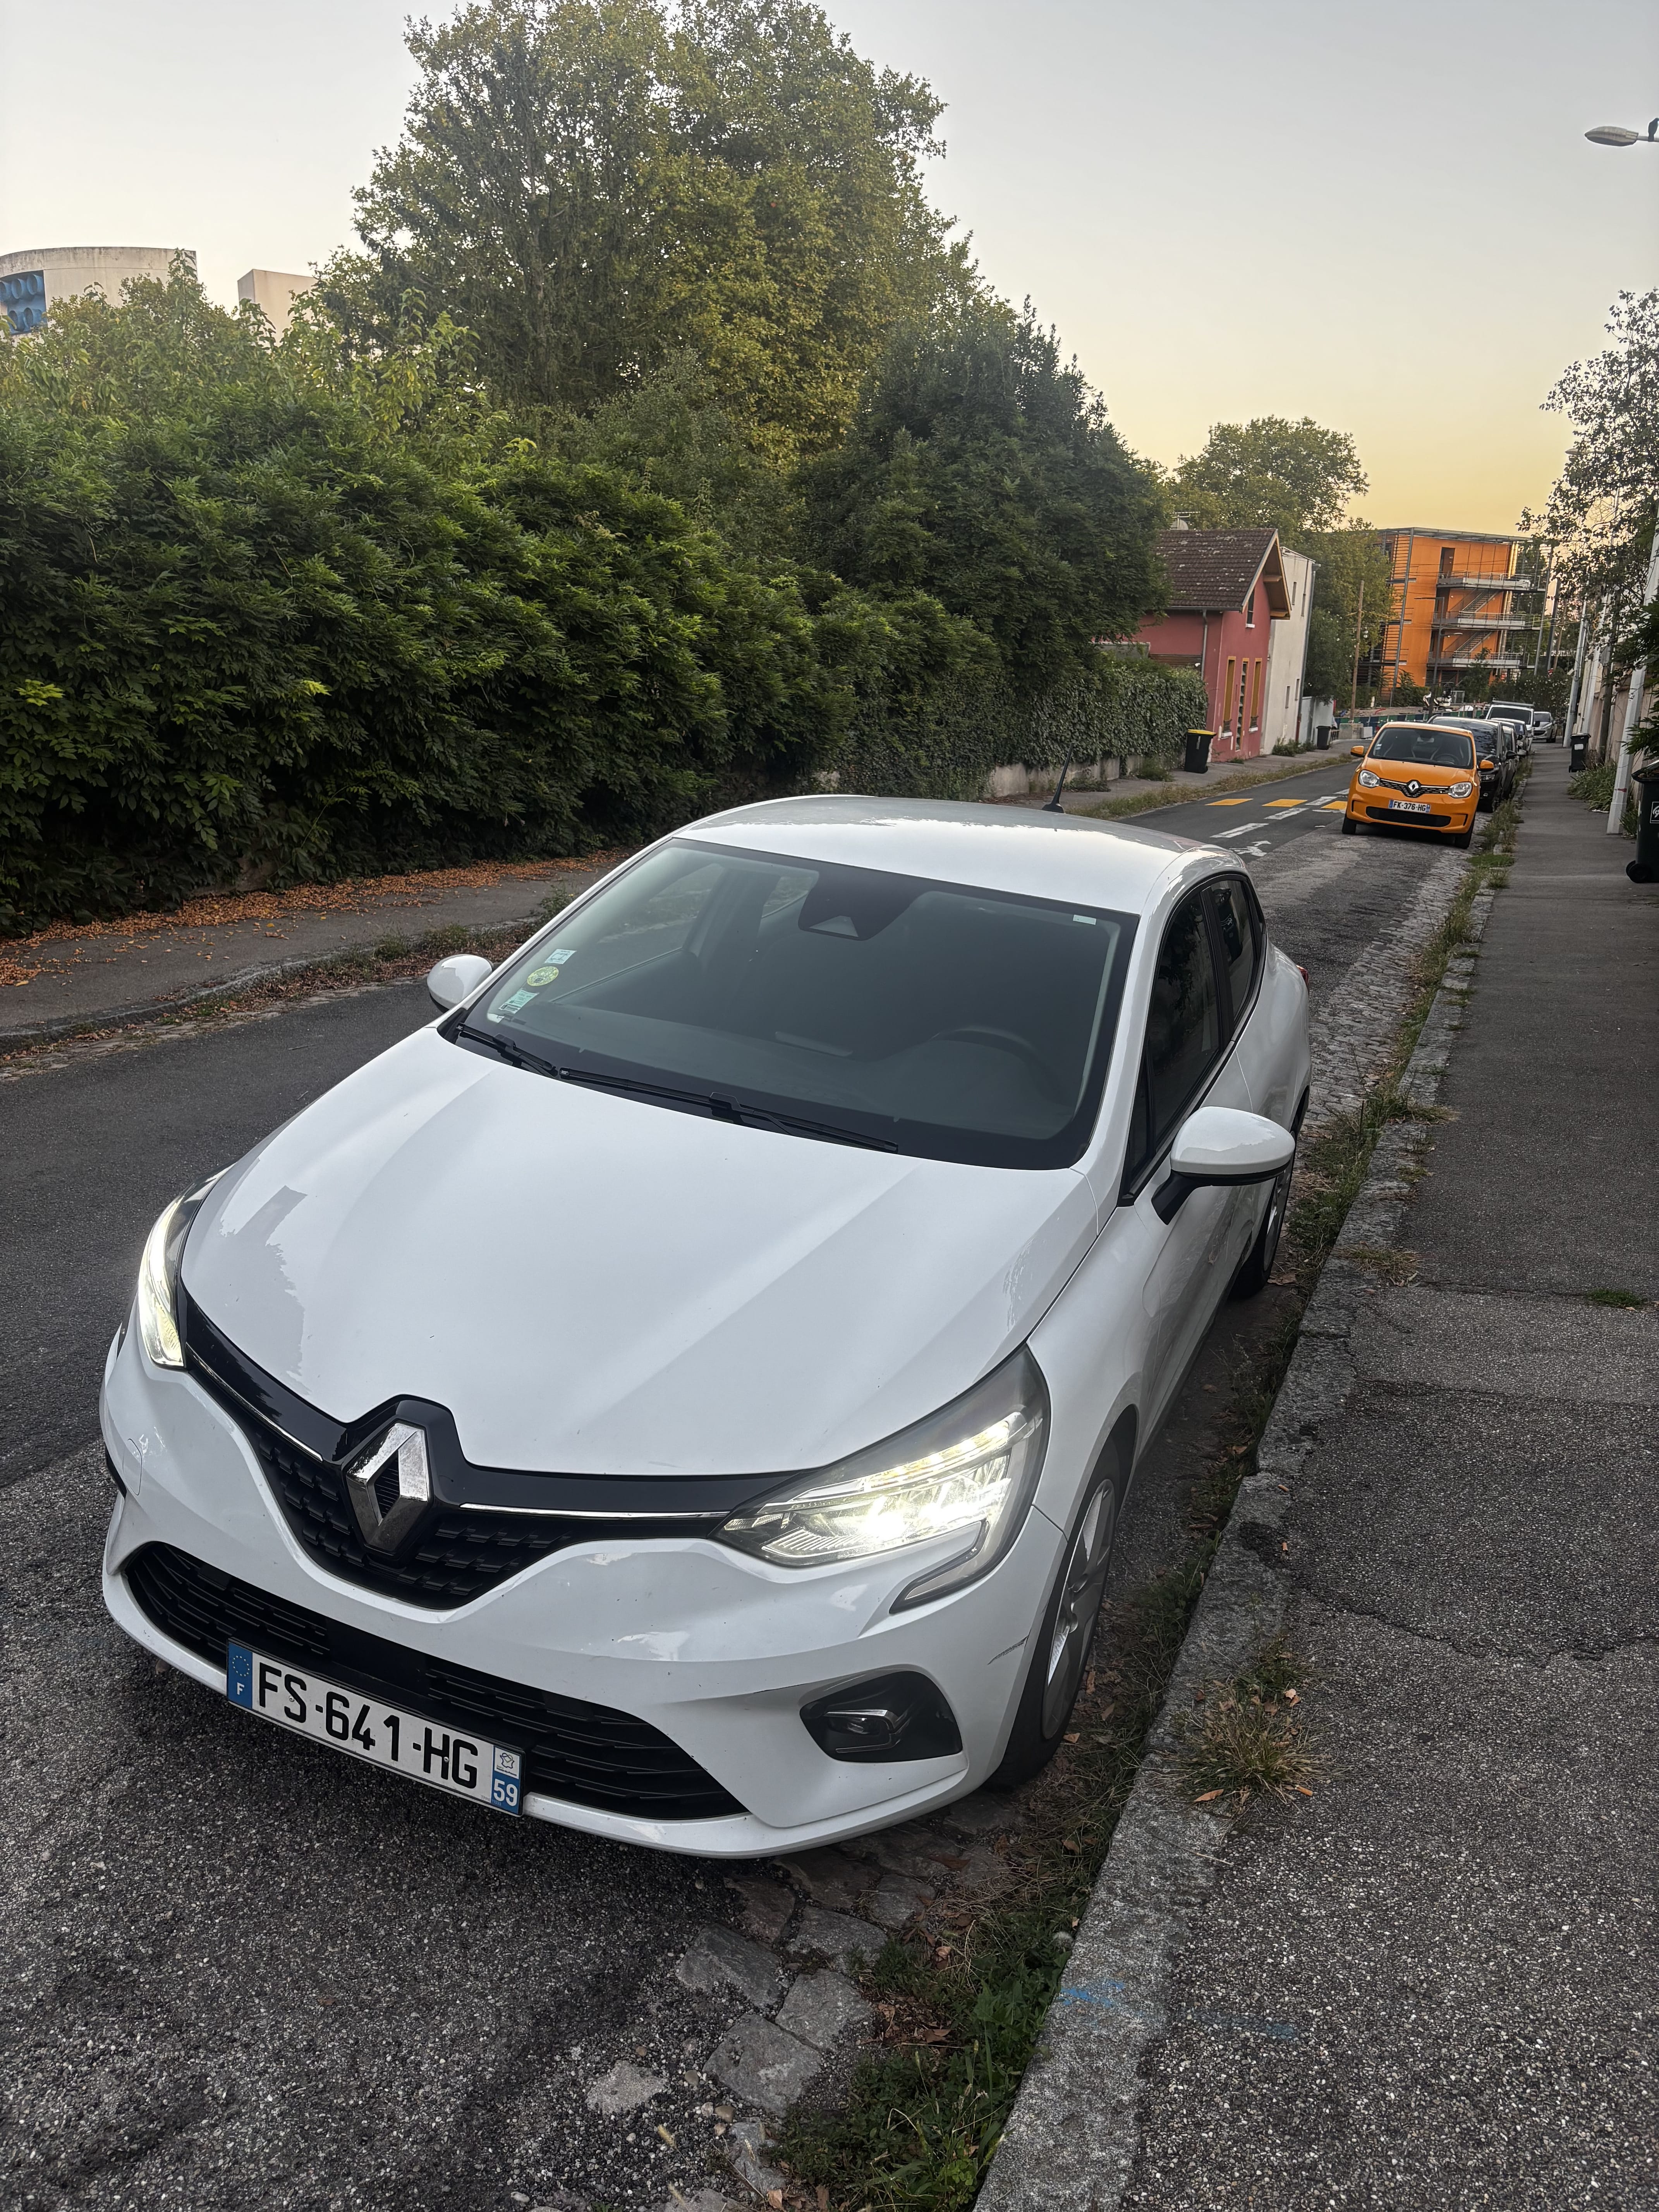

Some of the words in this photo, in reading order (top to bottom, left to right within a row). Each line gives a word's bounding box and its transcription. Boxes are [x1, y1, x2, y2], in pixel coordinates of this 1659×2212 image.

[1393, 801, 1426, 811] FK-376-HG
[237, 1682, 245, 1695] F
[259, 1662, 477, 1789] FS-641-HG
[493, 1779, 518, 1807] 59
